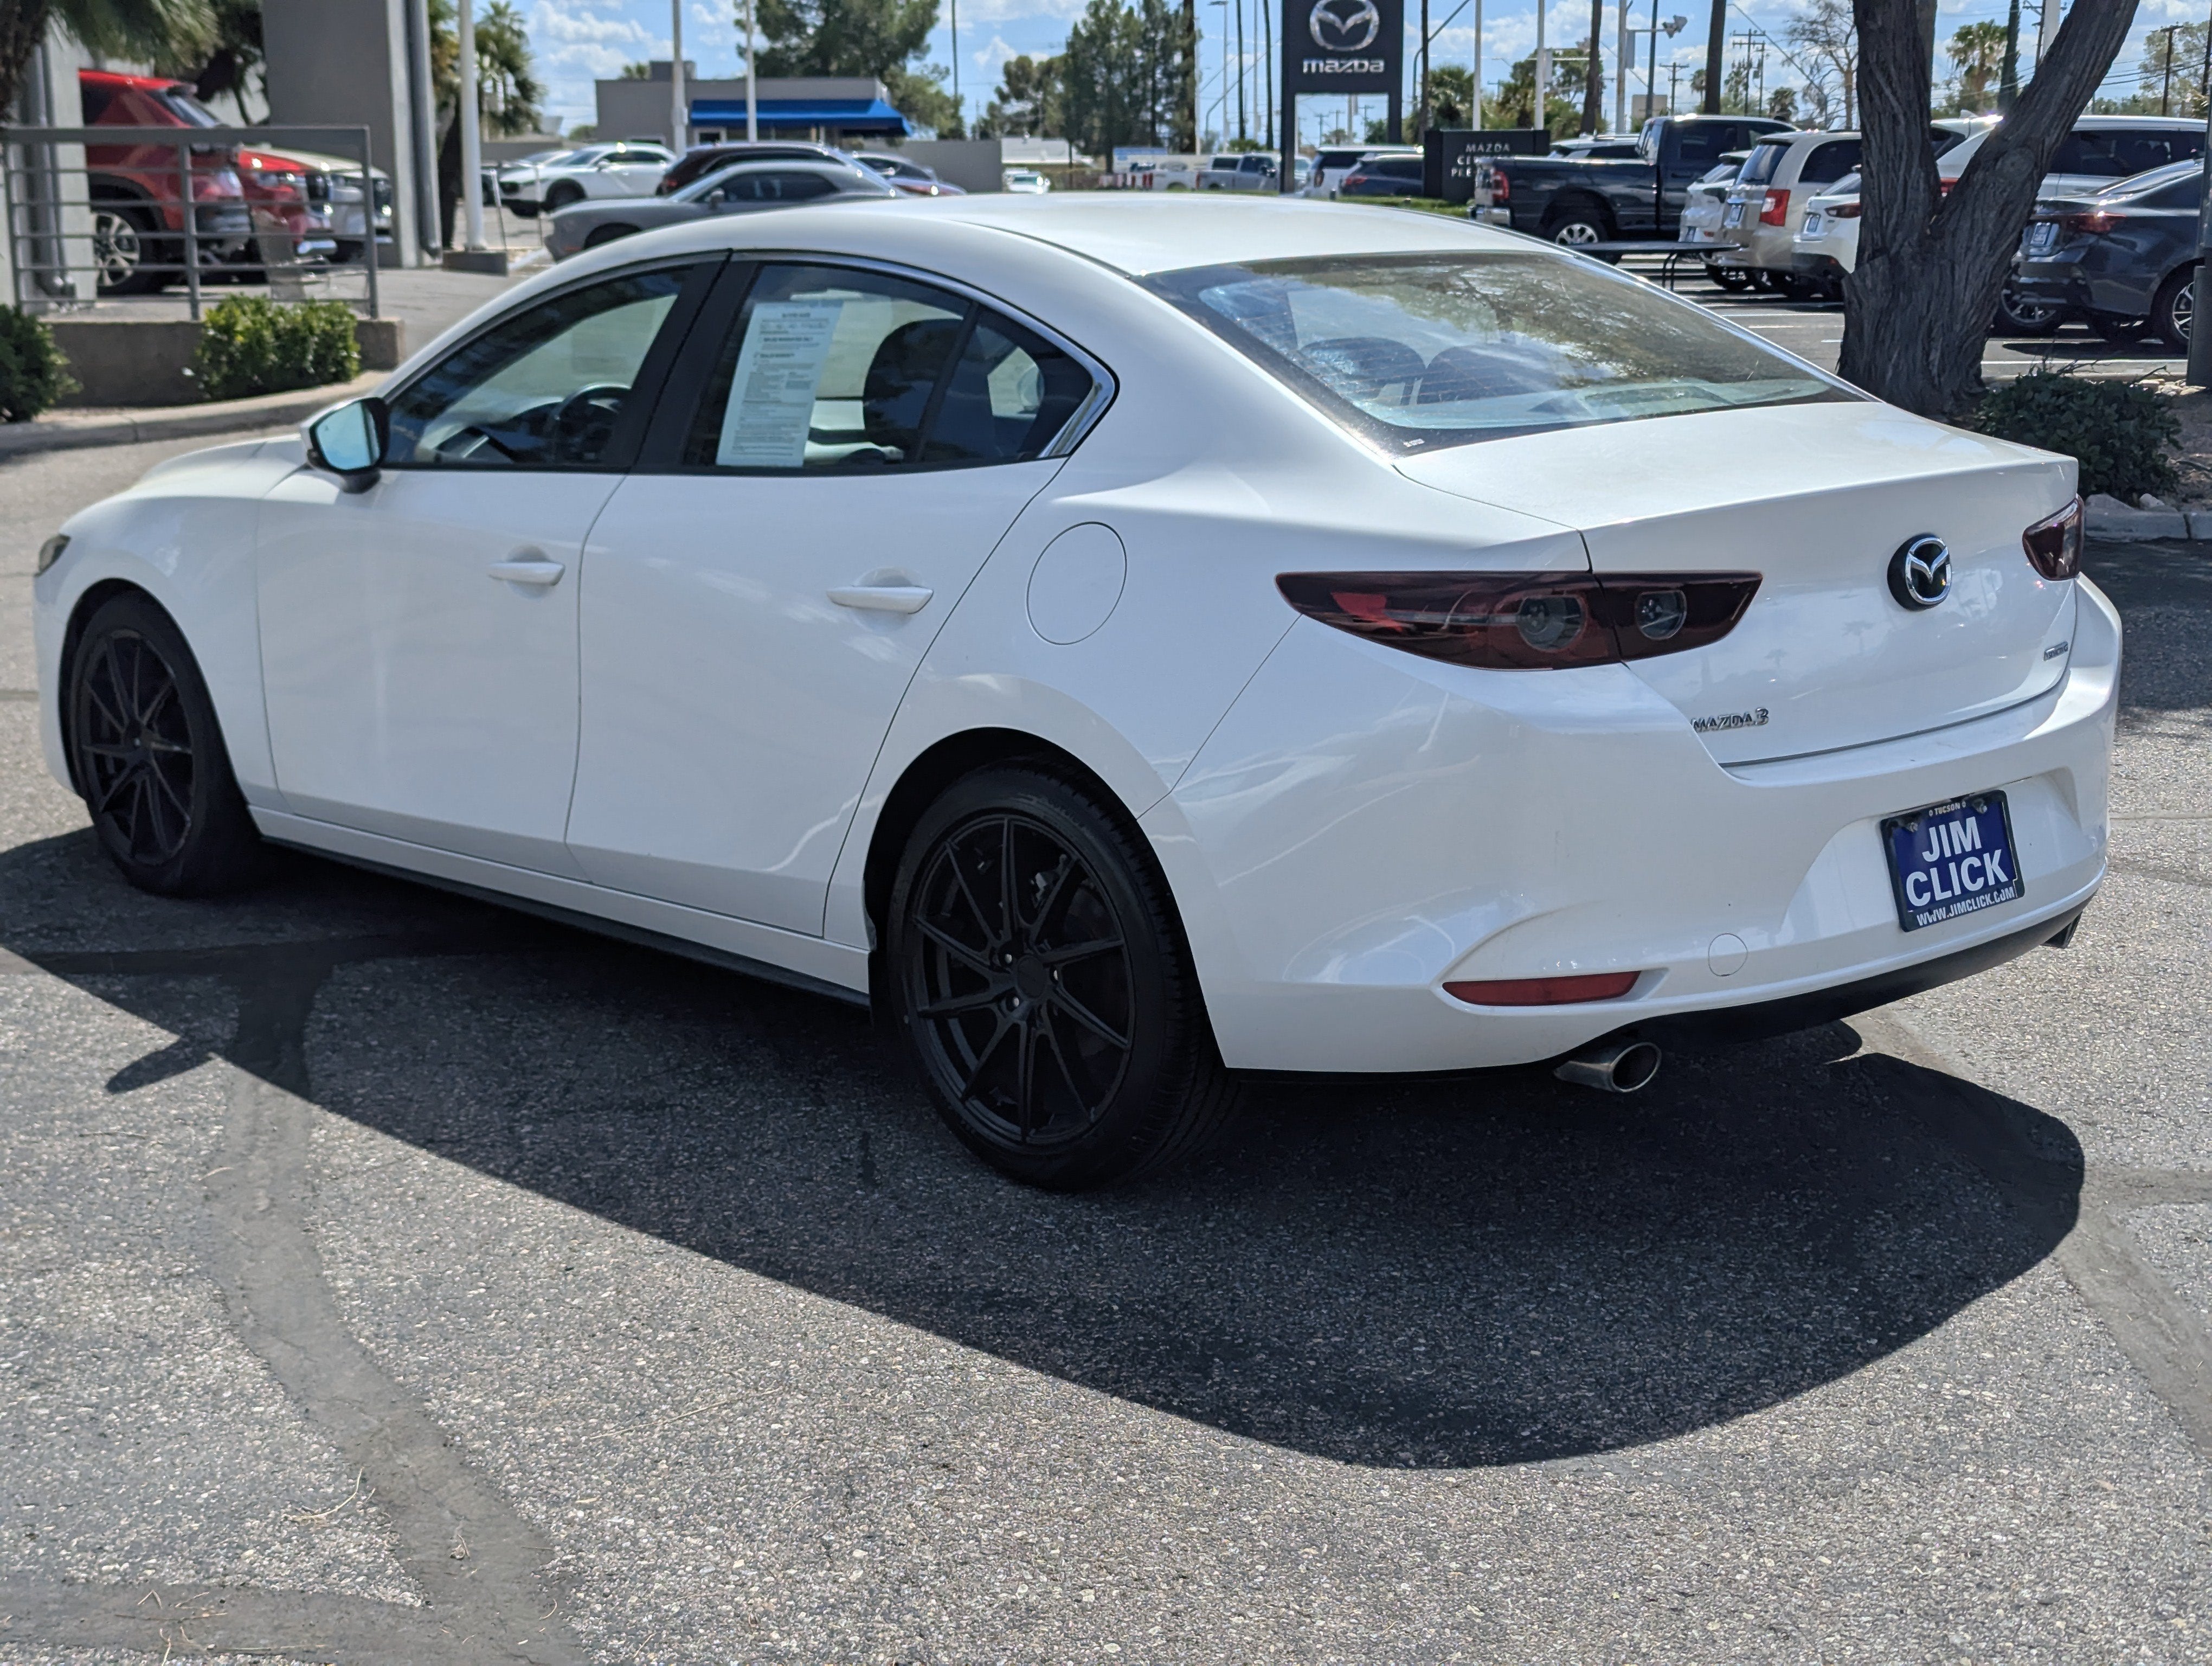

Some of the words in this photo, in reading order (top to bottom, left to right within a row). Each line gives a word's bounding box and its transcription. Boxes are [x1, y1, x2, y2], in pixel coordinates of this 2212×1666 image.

[1465, 143, 1510, 152] MAZDA
[1934, 802, 1960, 815] TUCSON
[1922, 816, 1982, 862] JIM
[1906, 849, 2009, 907] CLICK
[1916, 886, 2015, 926] WWW.JIMCLICK.COM
